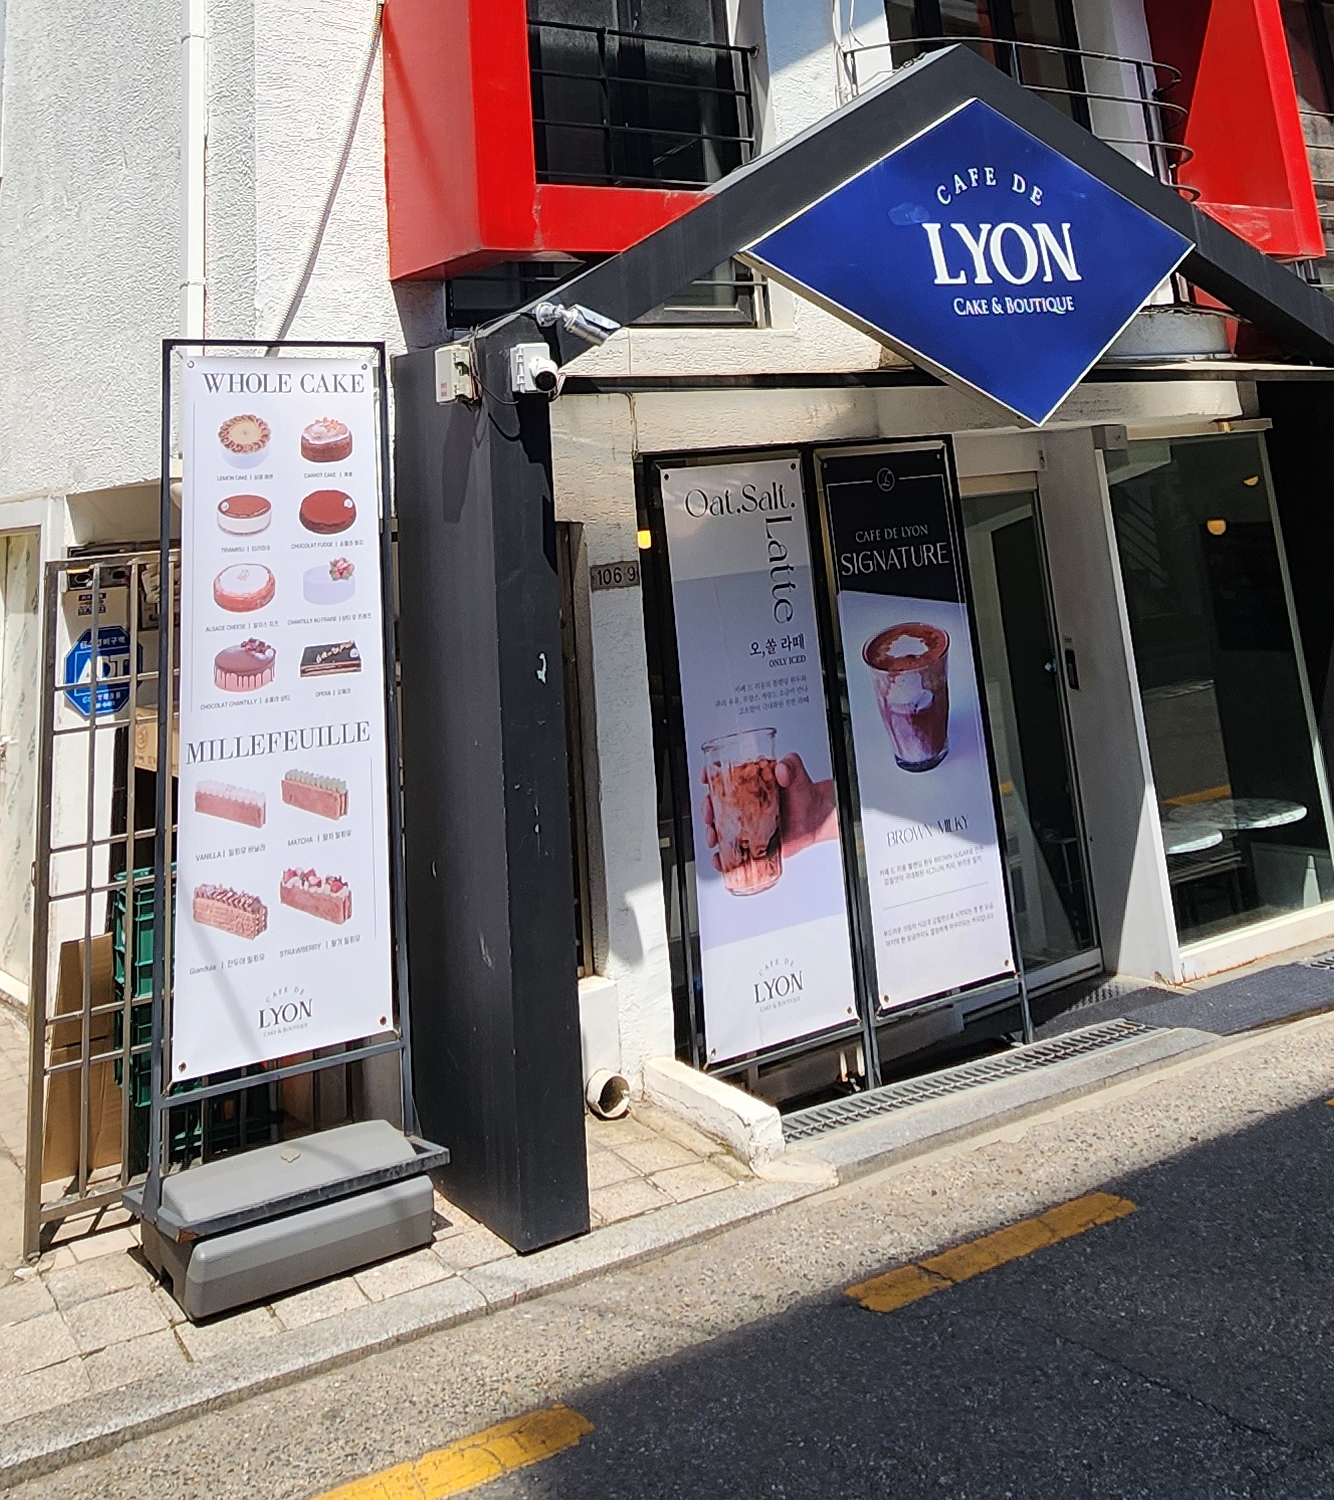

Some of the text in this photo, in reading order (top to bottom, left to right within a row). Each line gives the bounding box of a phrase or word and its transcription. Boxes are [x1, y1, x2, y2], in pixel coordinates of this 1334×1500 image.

[937, 167, 1043, 206] CAFE DE
[922, 222, 1082, 285] LYON
[954, 296, 1074, 315] CAKE & BOUTIQUE
[202, 373, 365, 394] WHOLE CAKE
[855, 524, 928, 543] CAFE DE LYON
[841, 542, 950, 576] SIGNATURE
[598, 567, 622, 586] 106
[764, 516, 798, 624] Latte
[206, 624, 225, 632] ALSACE
[781, 633, 805, 652] 라떼
[769, 655, 806, 668] ONLY ICED
[200, 699, 258, 710] CHOCOLAT CHANTILLY
[185, 721, 371, 765] MILLEFEUILLE
[887, 815, 969, 847] BROWN MILKY
[287, 837, 313, 846] MATCHA
[196, 852, 222, 862] VANILLA
[279, 943, 321, 958] STRAWBERRY
[266, 986, 305, 1002] CAFE DE
[753, 970, 803, 1004] LYON
[258, 999, 313, 1029] LYON
